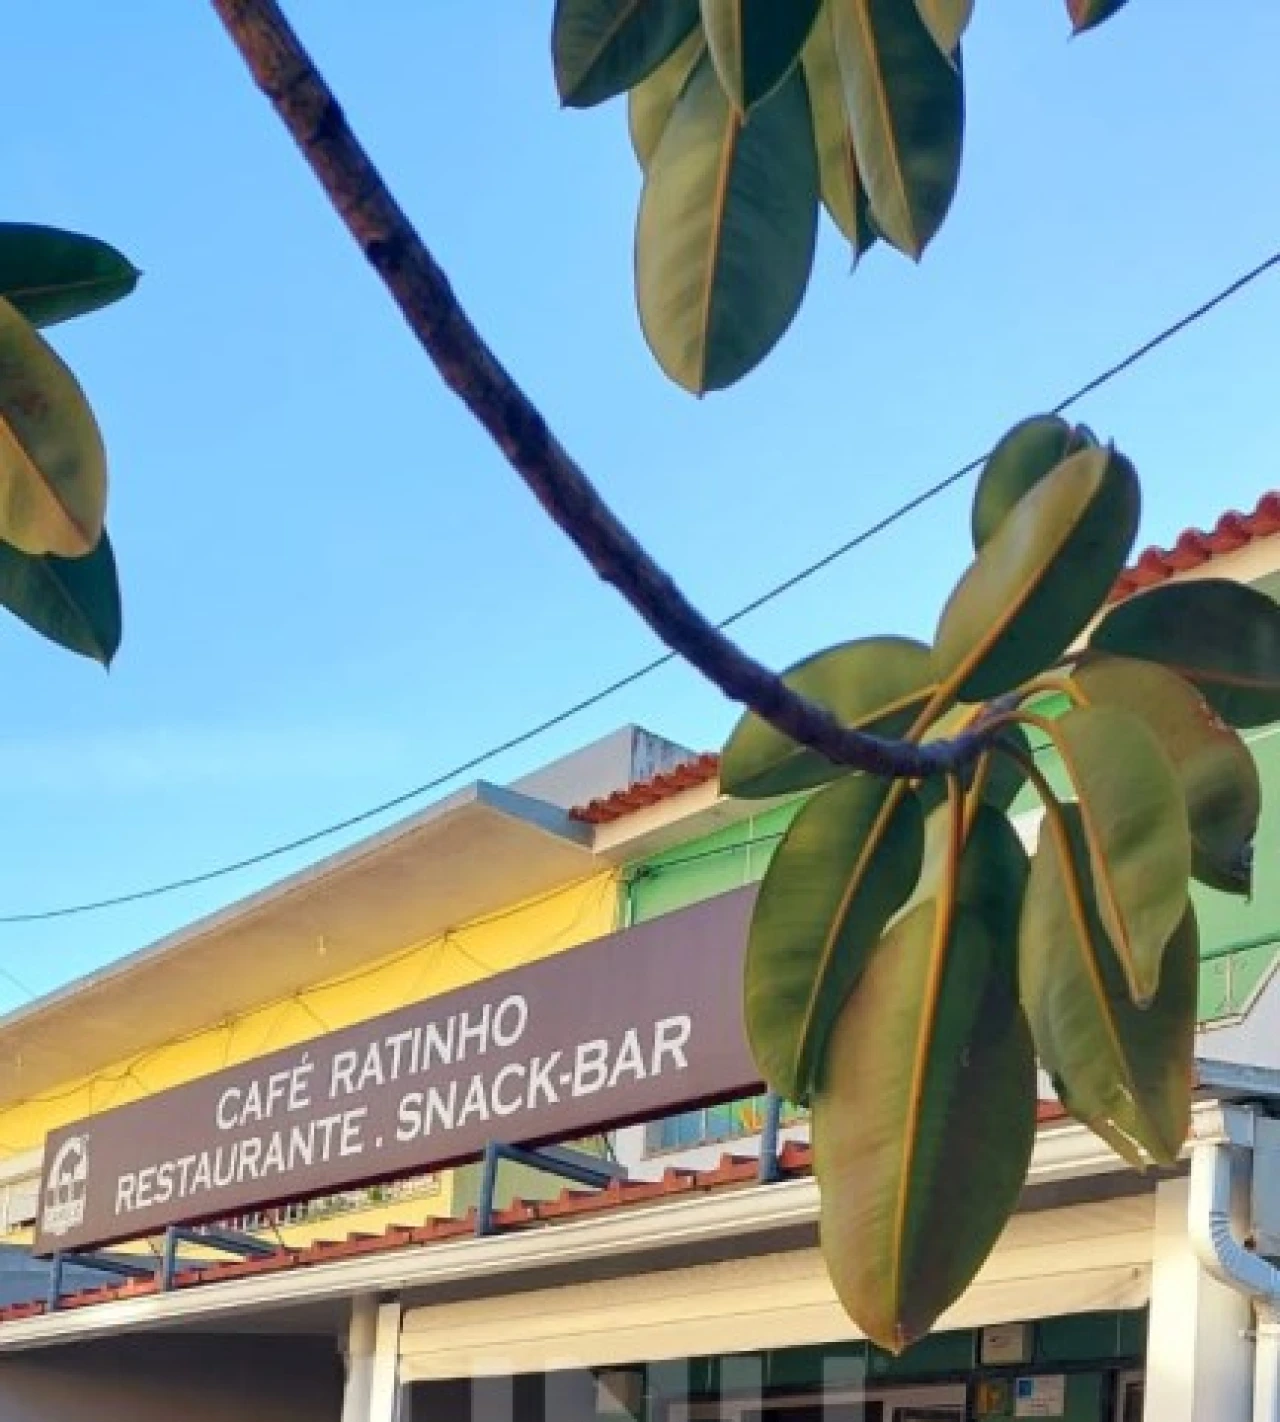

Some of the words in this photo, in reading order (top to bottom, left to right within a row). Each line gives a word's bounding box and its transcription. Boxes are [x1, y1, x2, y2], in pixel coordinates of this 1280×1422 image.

[114, 1107, 368, 1216] RESTAURANTE
[396, 1014, 692, 1142] SNACK-BAR
[215, 1051, 314, 1130] CAFÉ
[328, 994, 529, 1100] RATINHO
